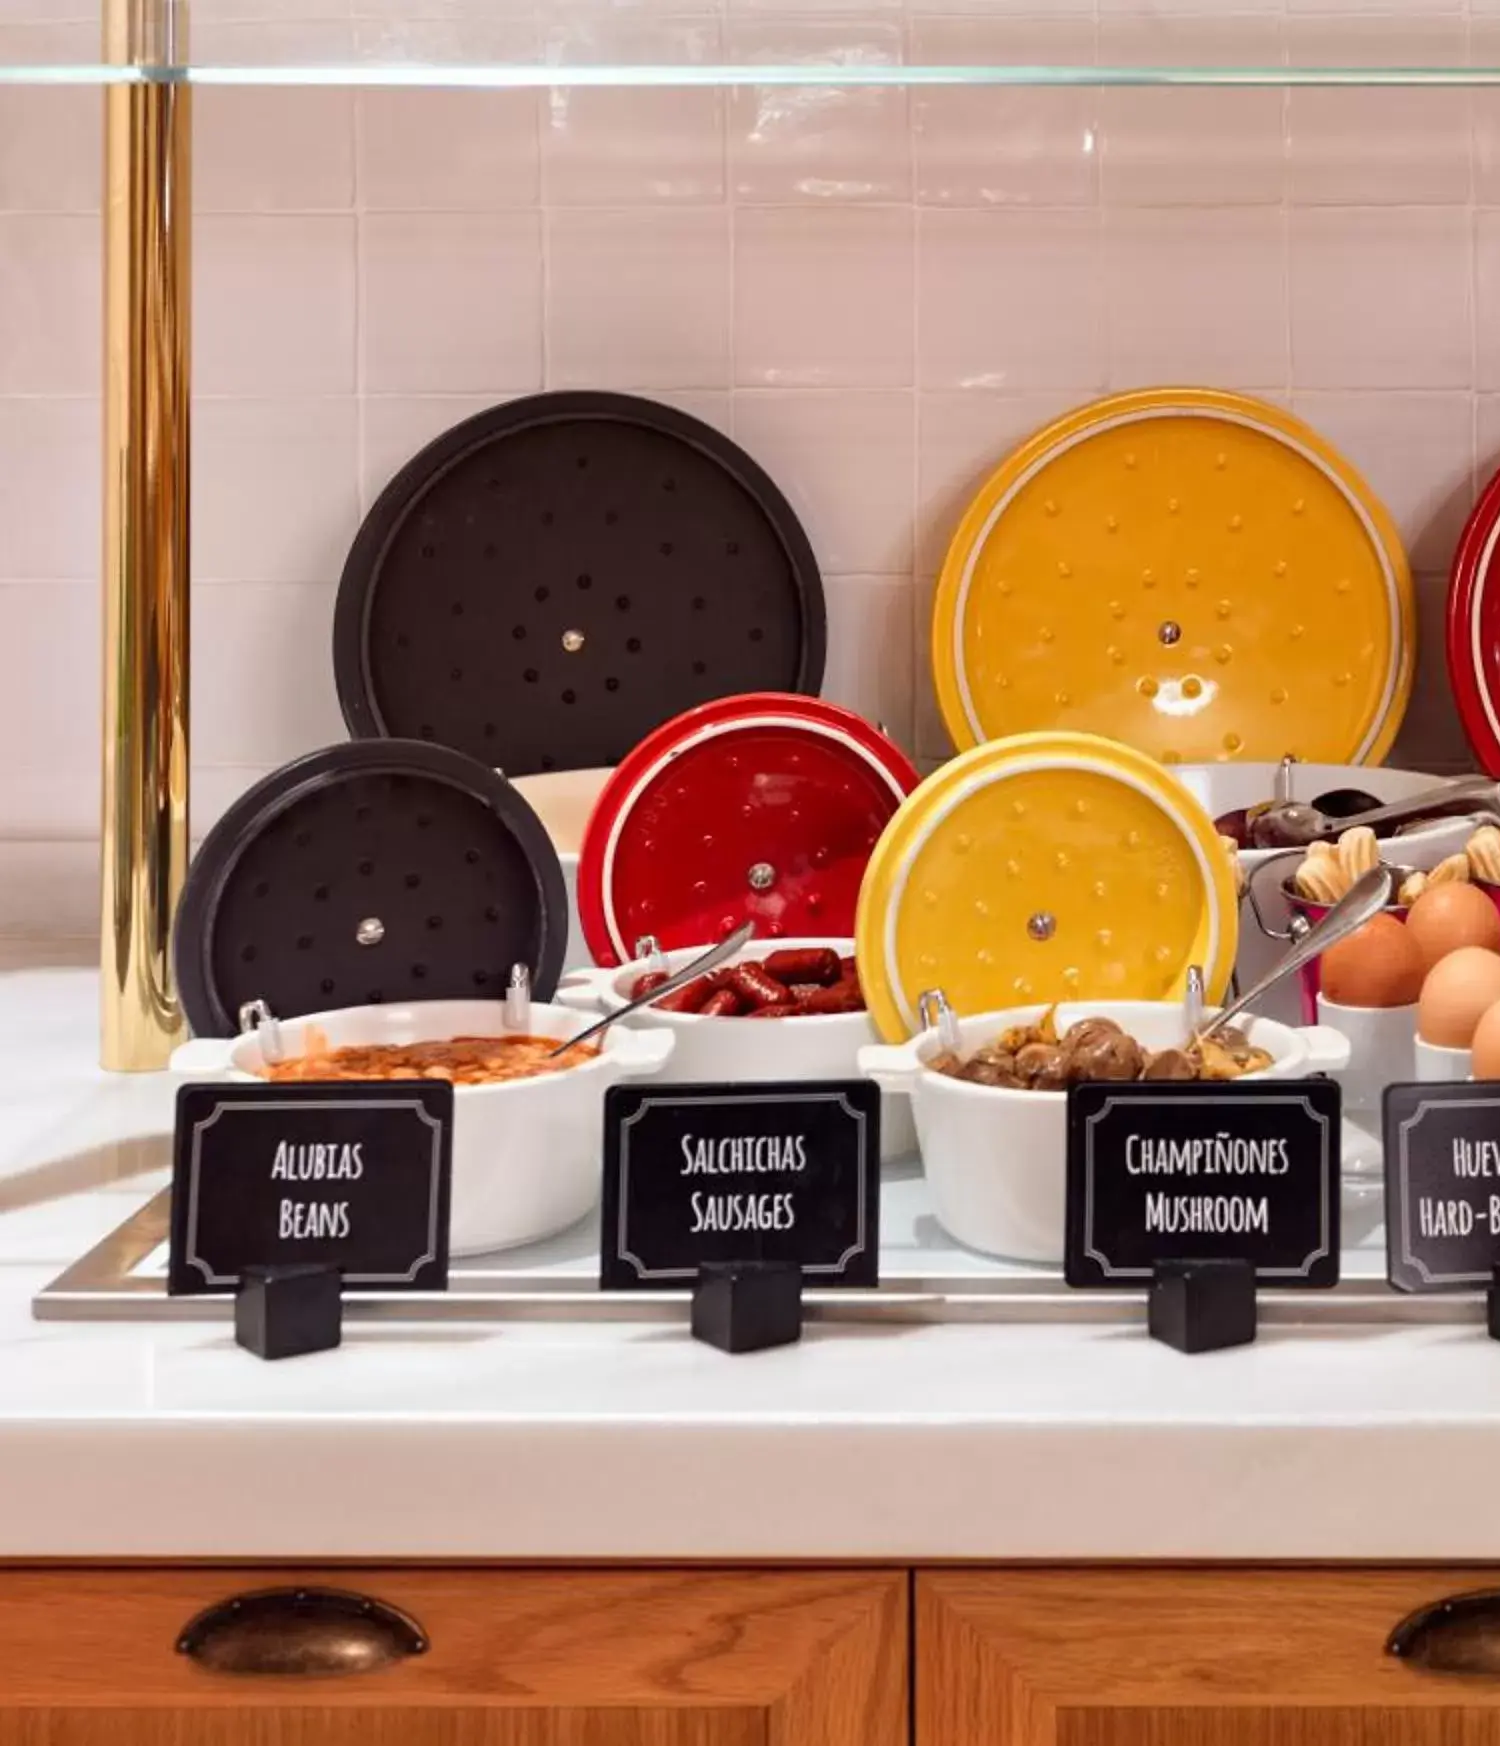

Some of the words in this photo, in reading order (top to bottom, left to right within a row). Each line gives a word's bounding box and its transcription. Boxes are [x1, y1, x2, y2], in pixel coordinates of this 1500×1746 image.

[270, 1139, 364, 1182] ALUBIAS
[679, 1133, 807, 1176] SALCHICHAS
[1124, 1131, 1290, 1177] CHAMPIÑONES
[278, 1198, 351, 1240] BEANS
[689, 1190, 796, 1234] SAUSAGES
[1144, 1191, 1269, 1235] MUSHROOM
